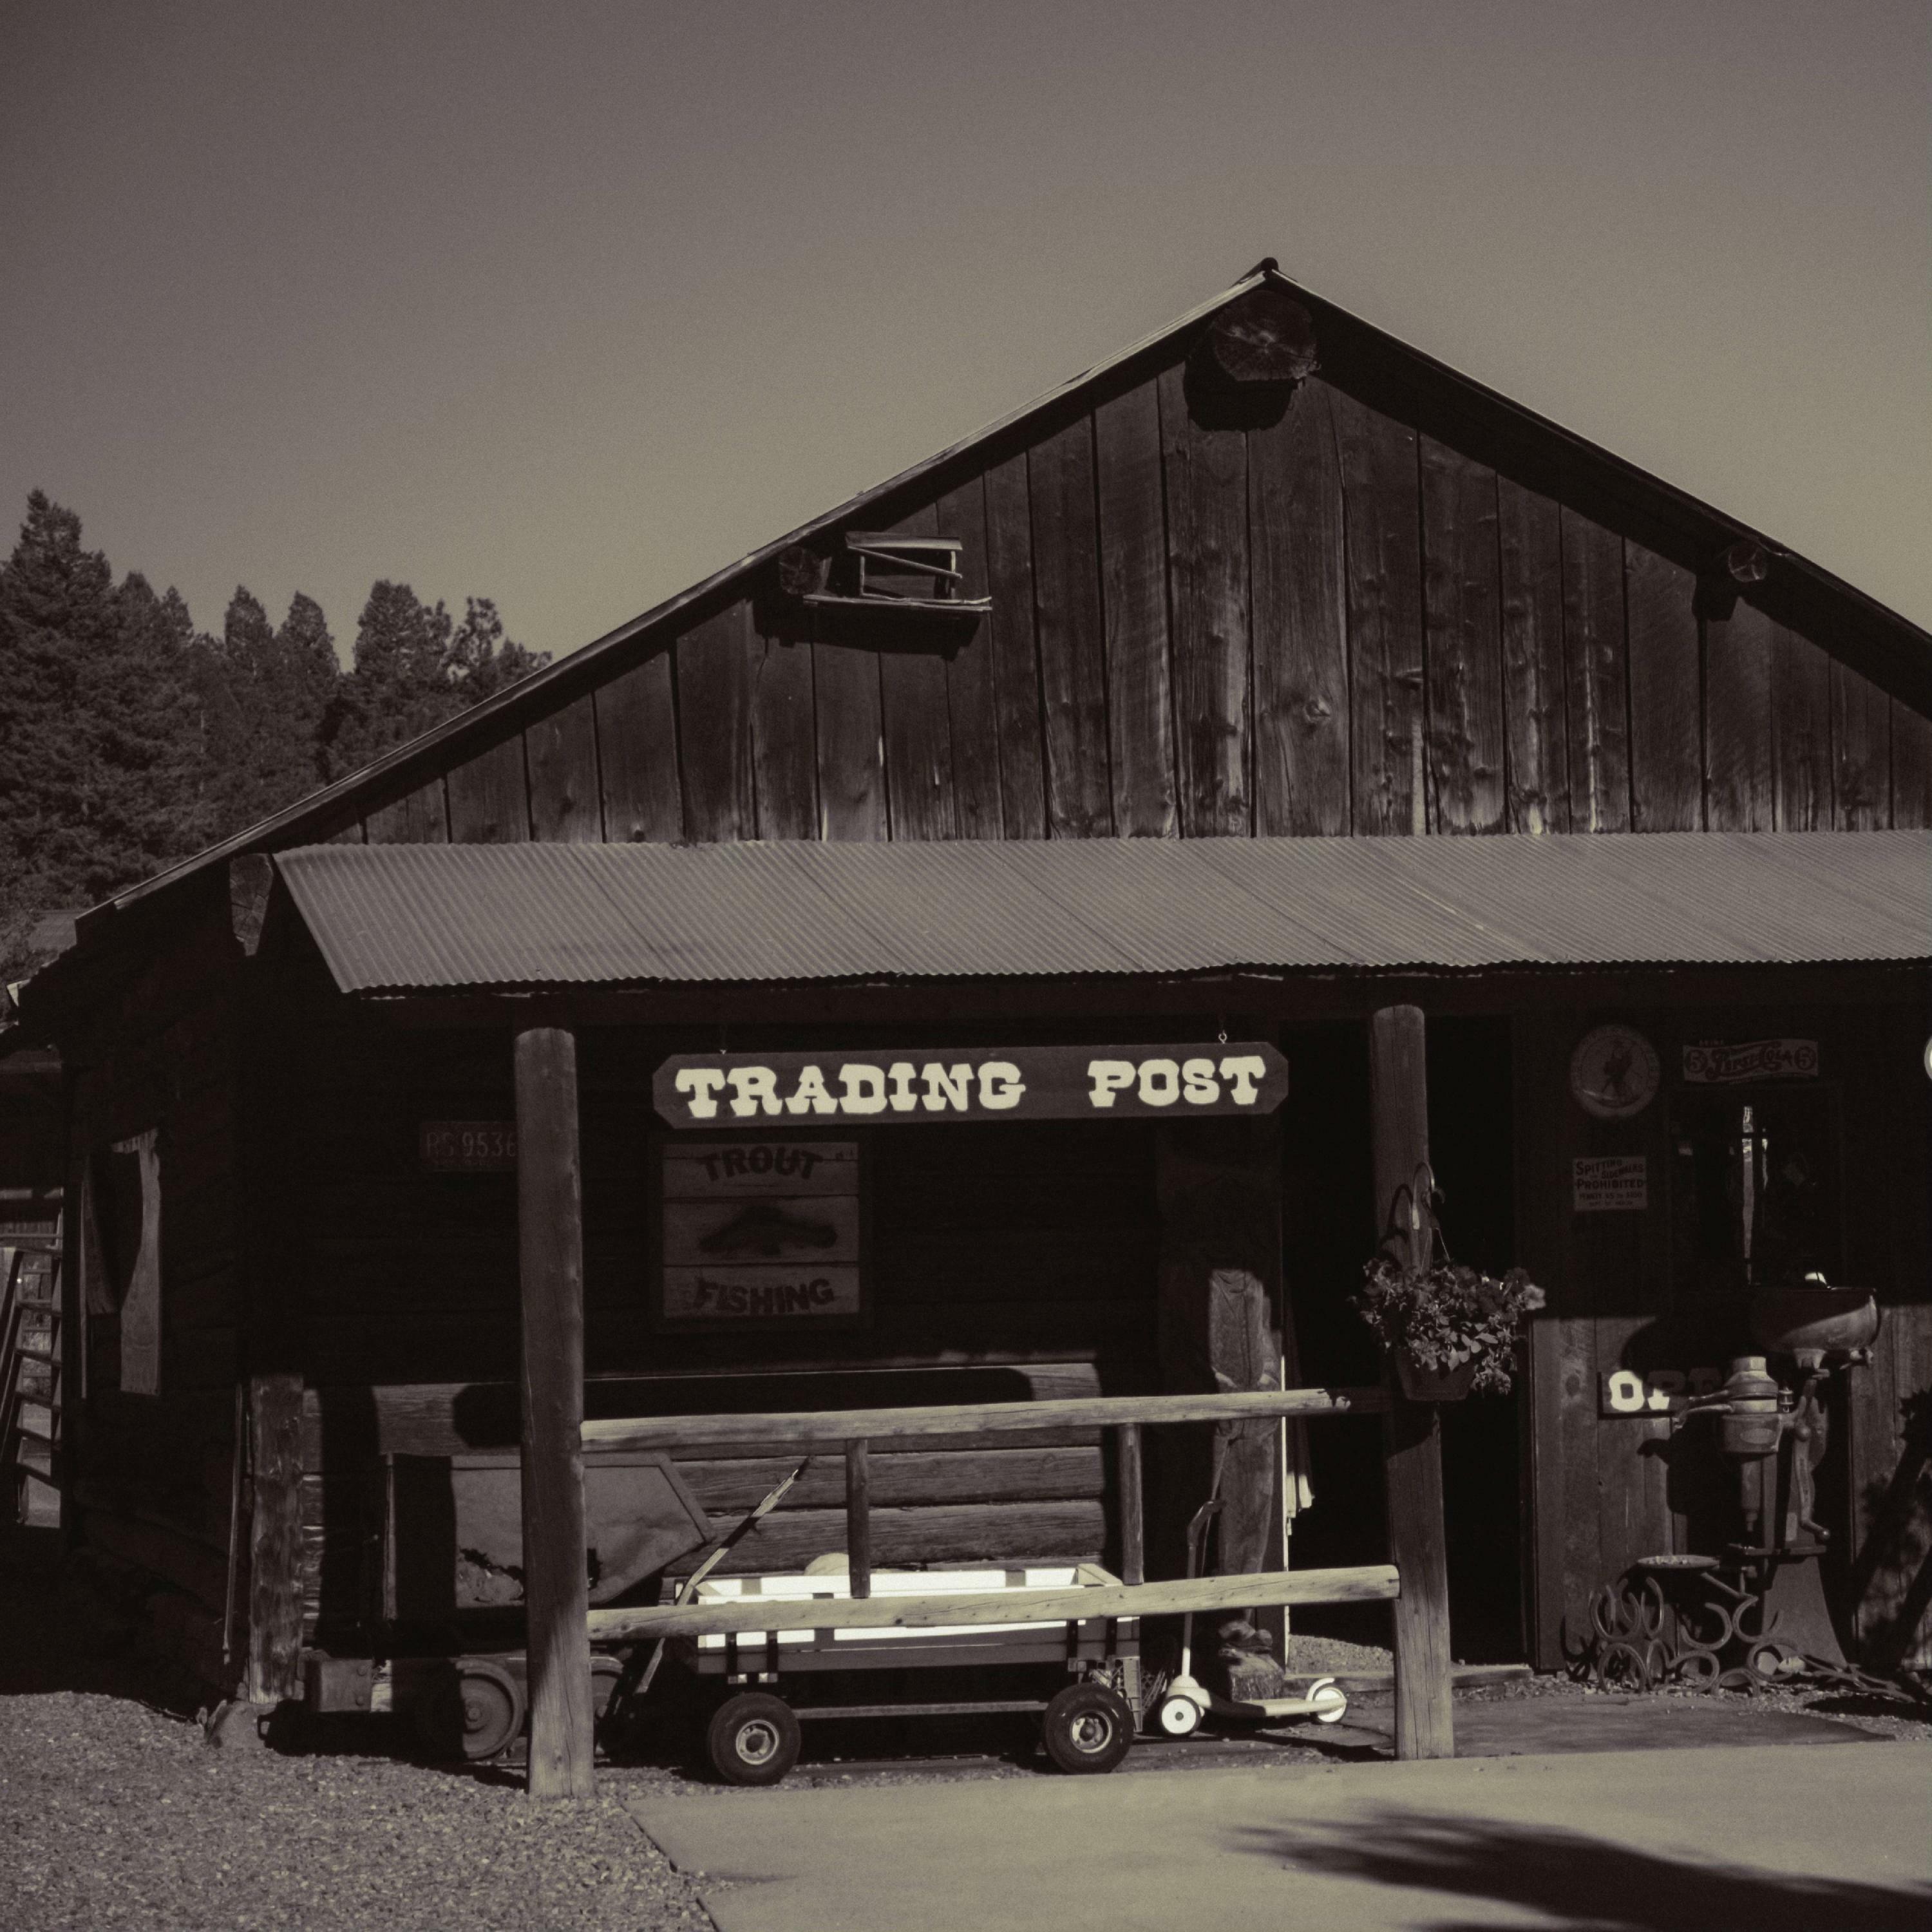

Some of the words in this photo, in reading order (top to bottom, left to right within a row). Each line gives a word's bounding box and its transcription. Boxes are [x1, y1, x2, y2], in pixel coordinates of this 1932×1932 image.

[675, 1061, 1026, 1118] TRADING
[1087, 1055, 1266, 1107] POST
[694, 1145, 824, 1181] TROUT
[1576, 1159, 1623, 1176] SPITTING
[1577, 1178, 1644, 1189] PROHIBITED
[693, 1277, 835, 1314] FISHING
